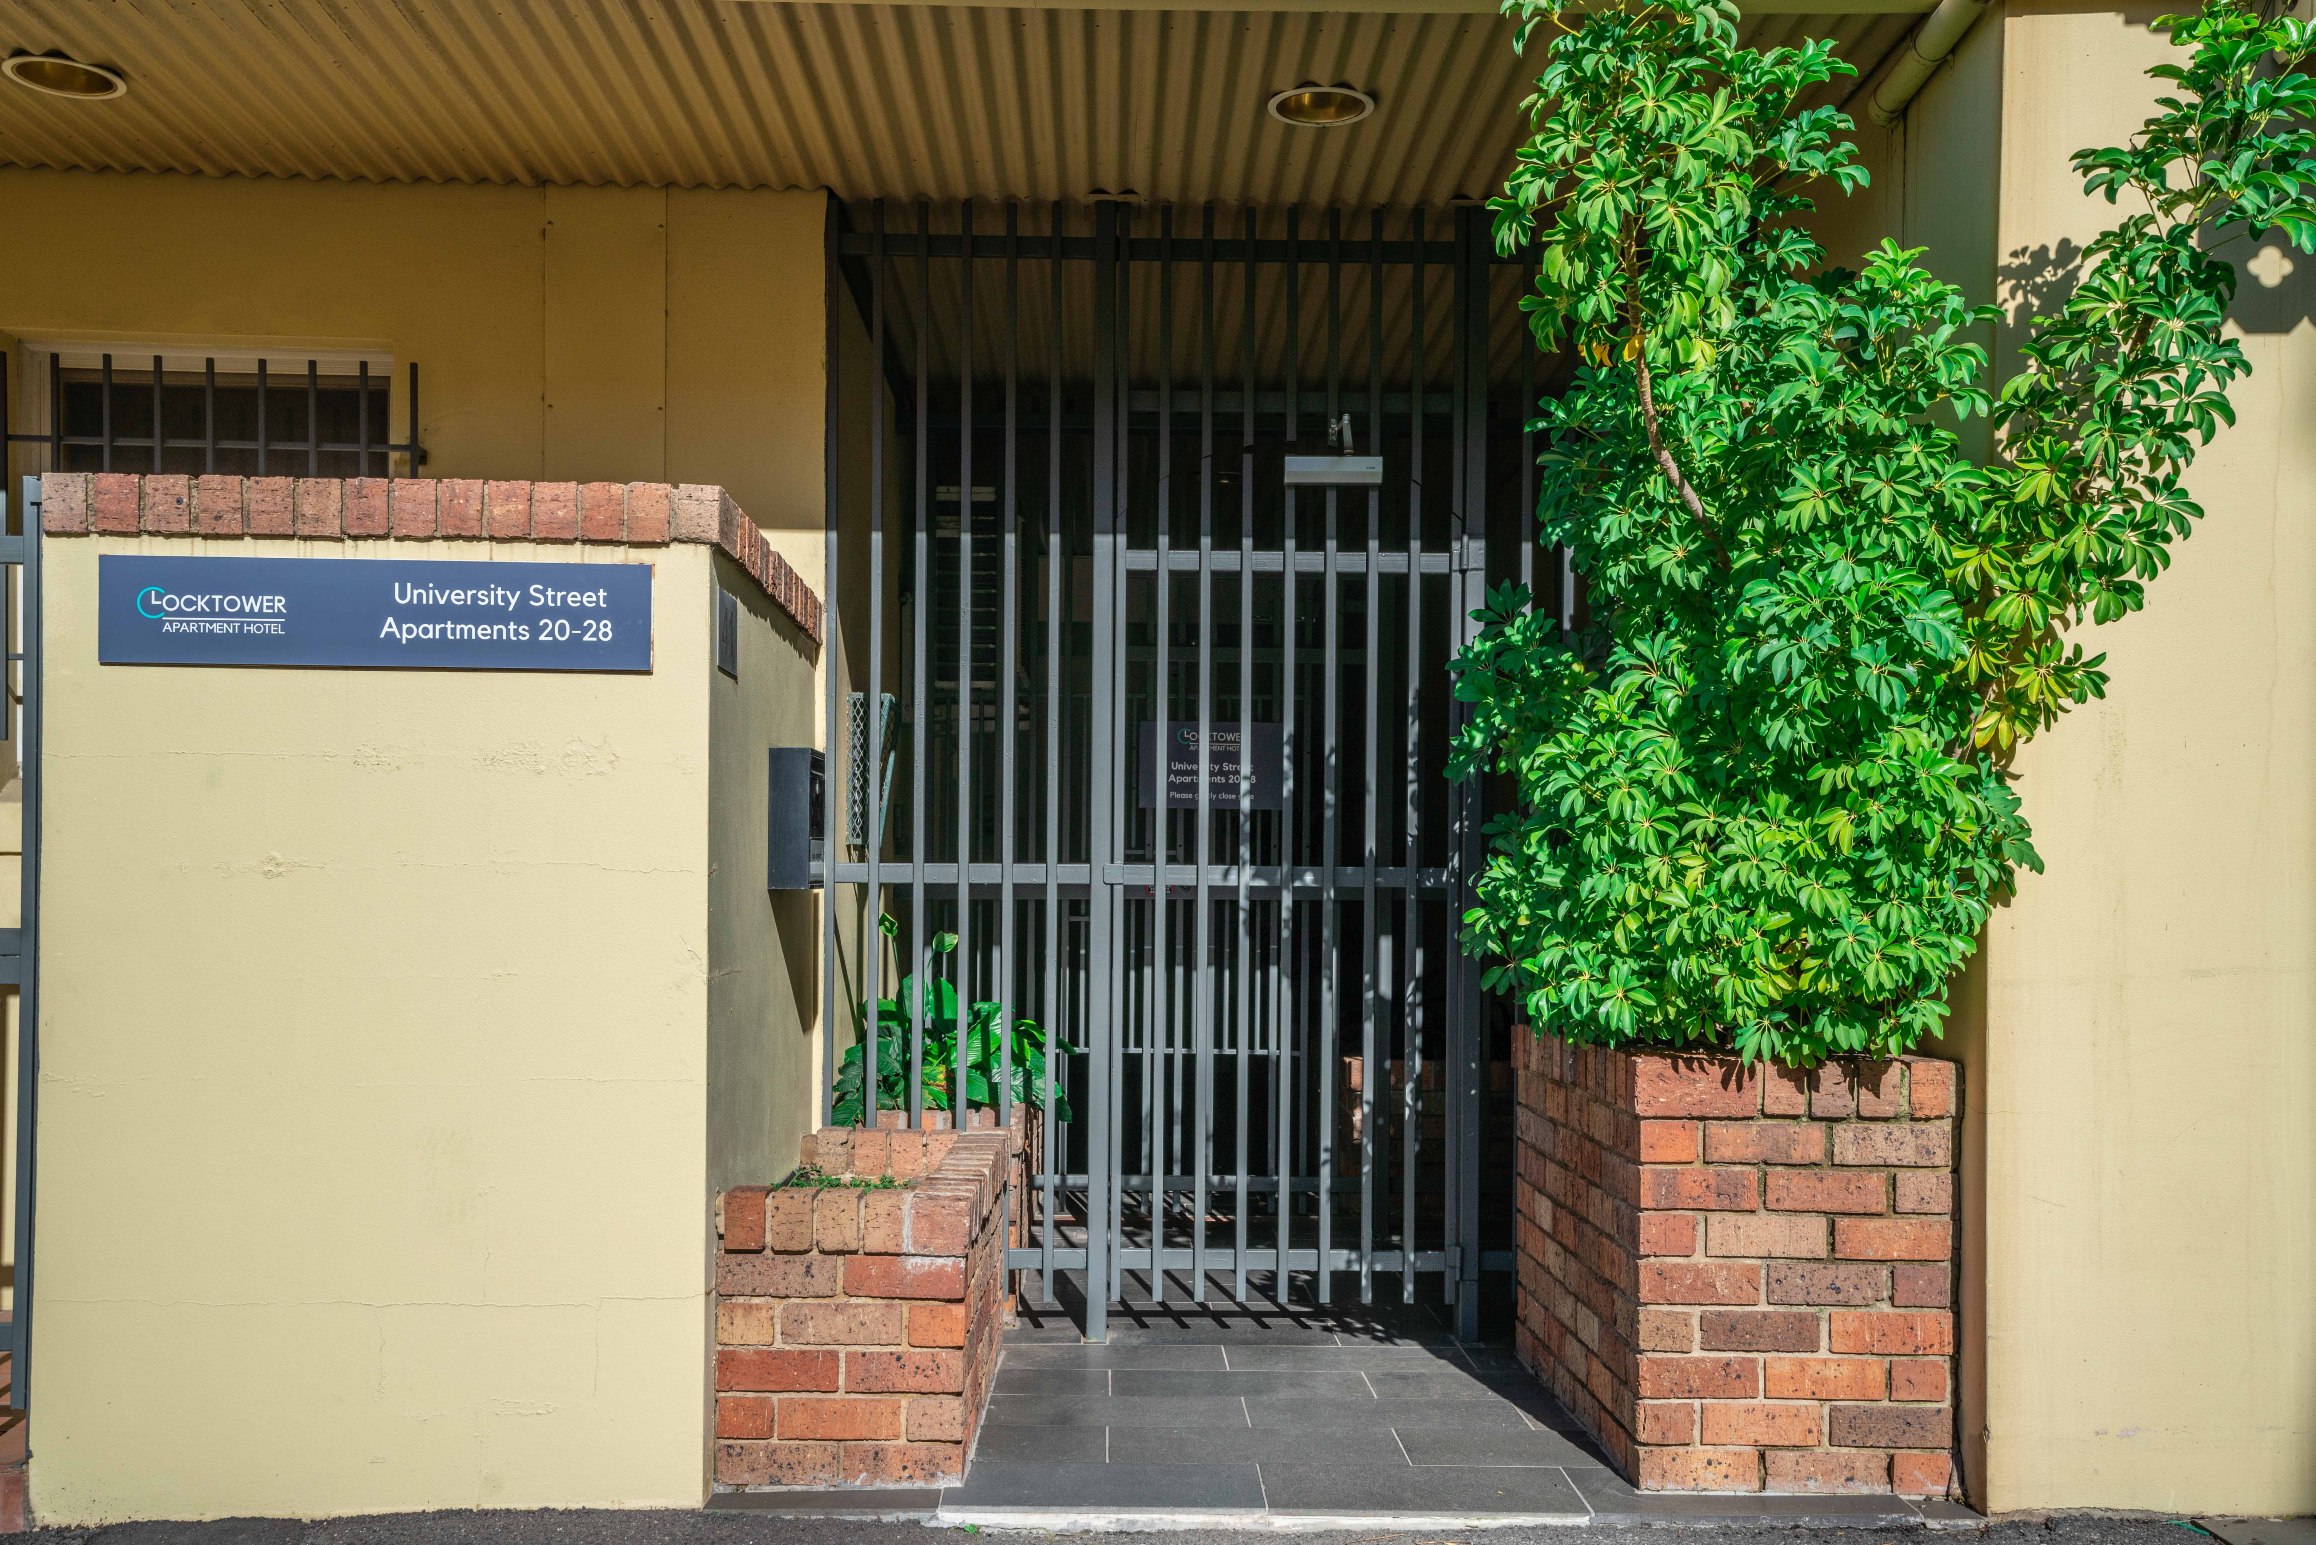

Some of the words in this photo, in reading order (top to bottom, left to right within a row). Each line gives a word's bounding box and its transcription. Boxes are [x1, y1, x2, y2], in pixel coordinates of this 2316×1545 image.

[393, 582, 521, 610] University
[529, 584, 608, 608] Street
[162, 622, 240, 634] APARTMENT
[243, 623, 286, 635] HOTEL
[380, 616, 530, 644] Apartments
[538, 619, 613, 642] 20-28
[1171, 761, 1220, 772] Univety
[1168, 774, 1226, 784] Apartnts
[1228, 775, 1256, 784] 208
[1170, 791, 1193, 799] Please
[1218, 792, 1237, 800] close
